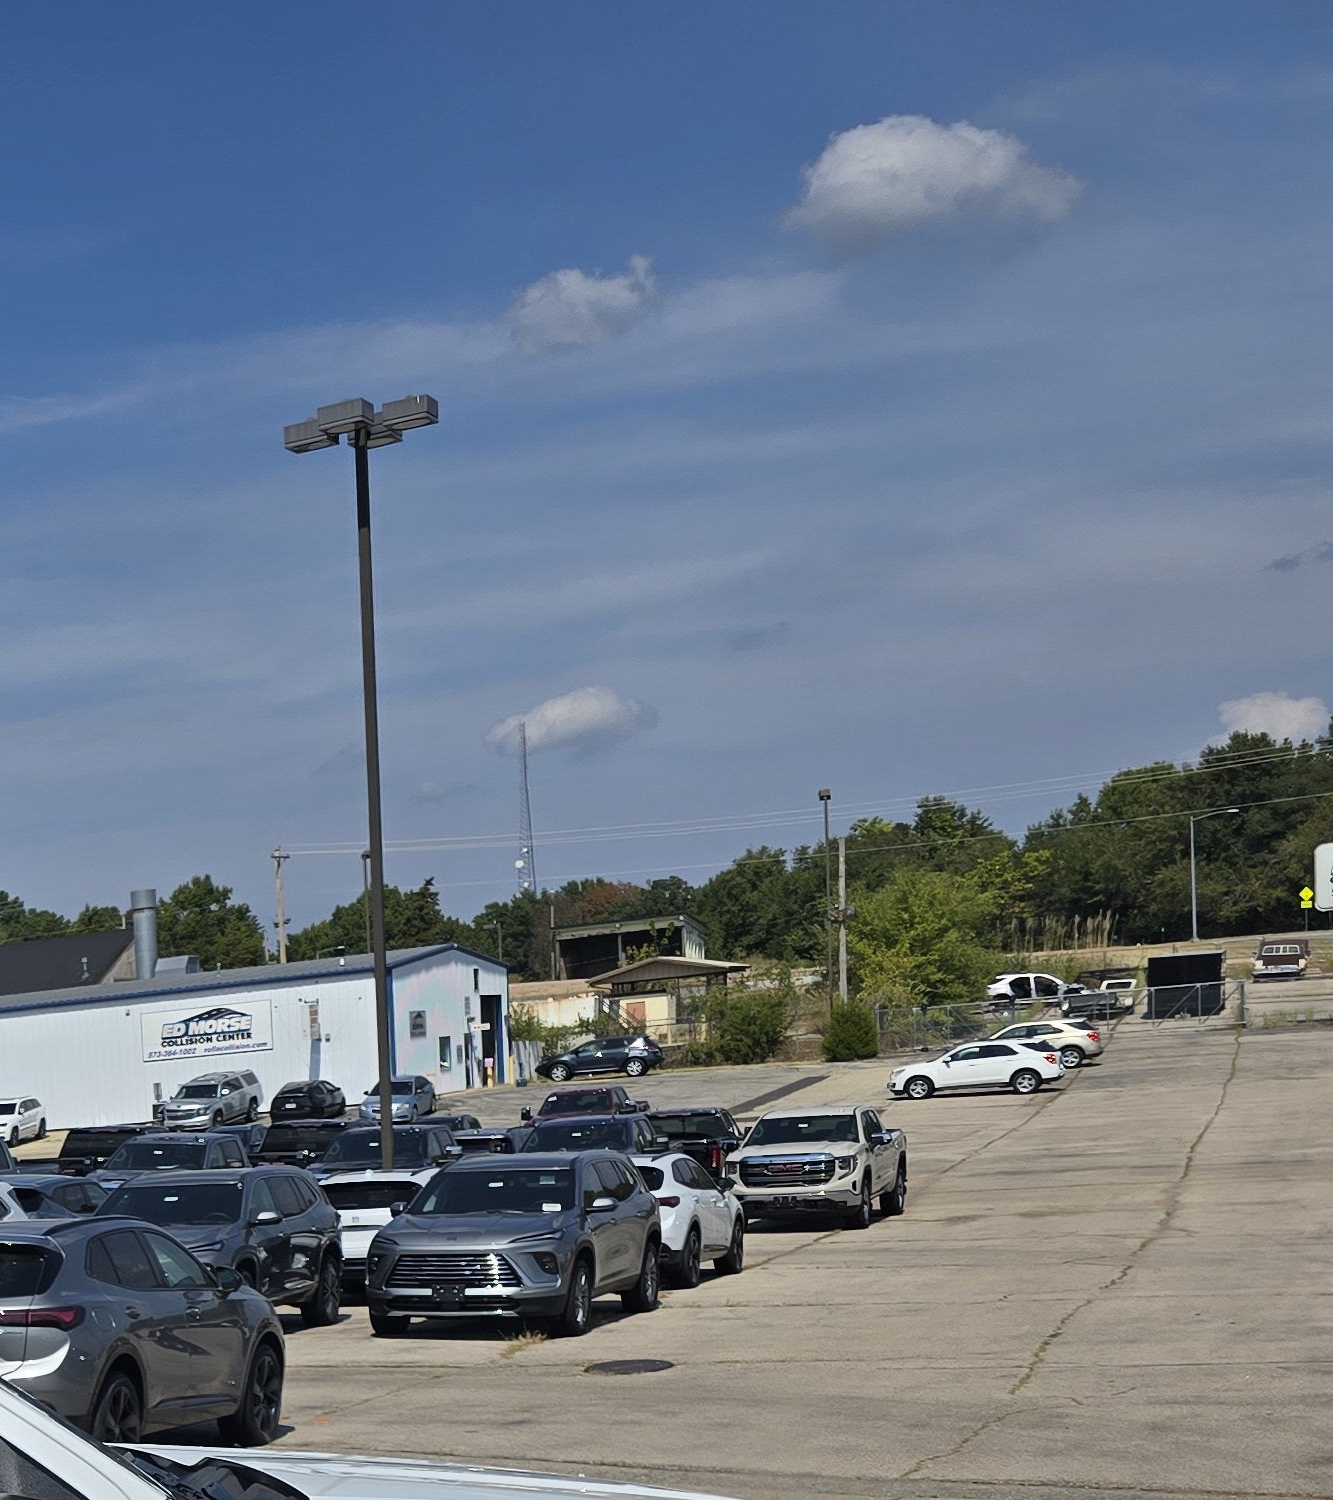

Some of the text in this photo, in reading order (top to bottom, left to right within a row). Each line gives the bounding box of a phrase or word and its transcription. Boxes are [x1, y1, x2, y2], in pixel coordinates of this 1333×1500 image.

[163, 1016, 252, 1037] ED MORSE
[161, 1033, 253, 1048] COLLISION CENTER
